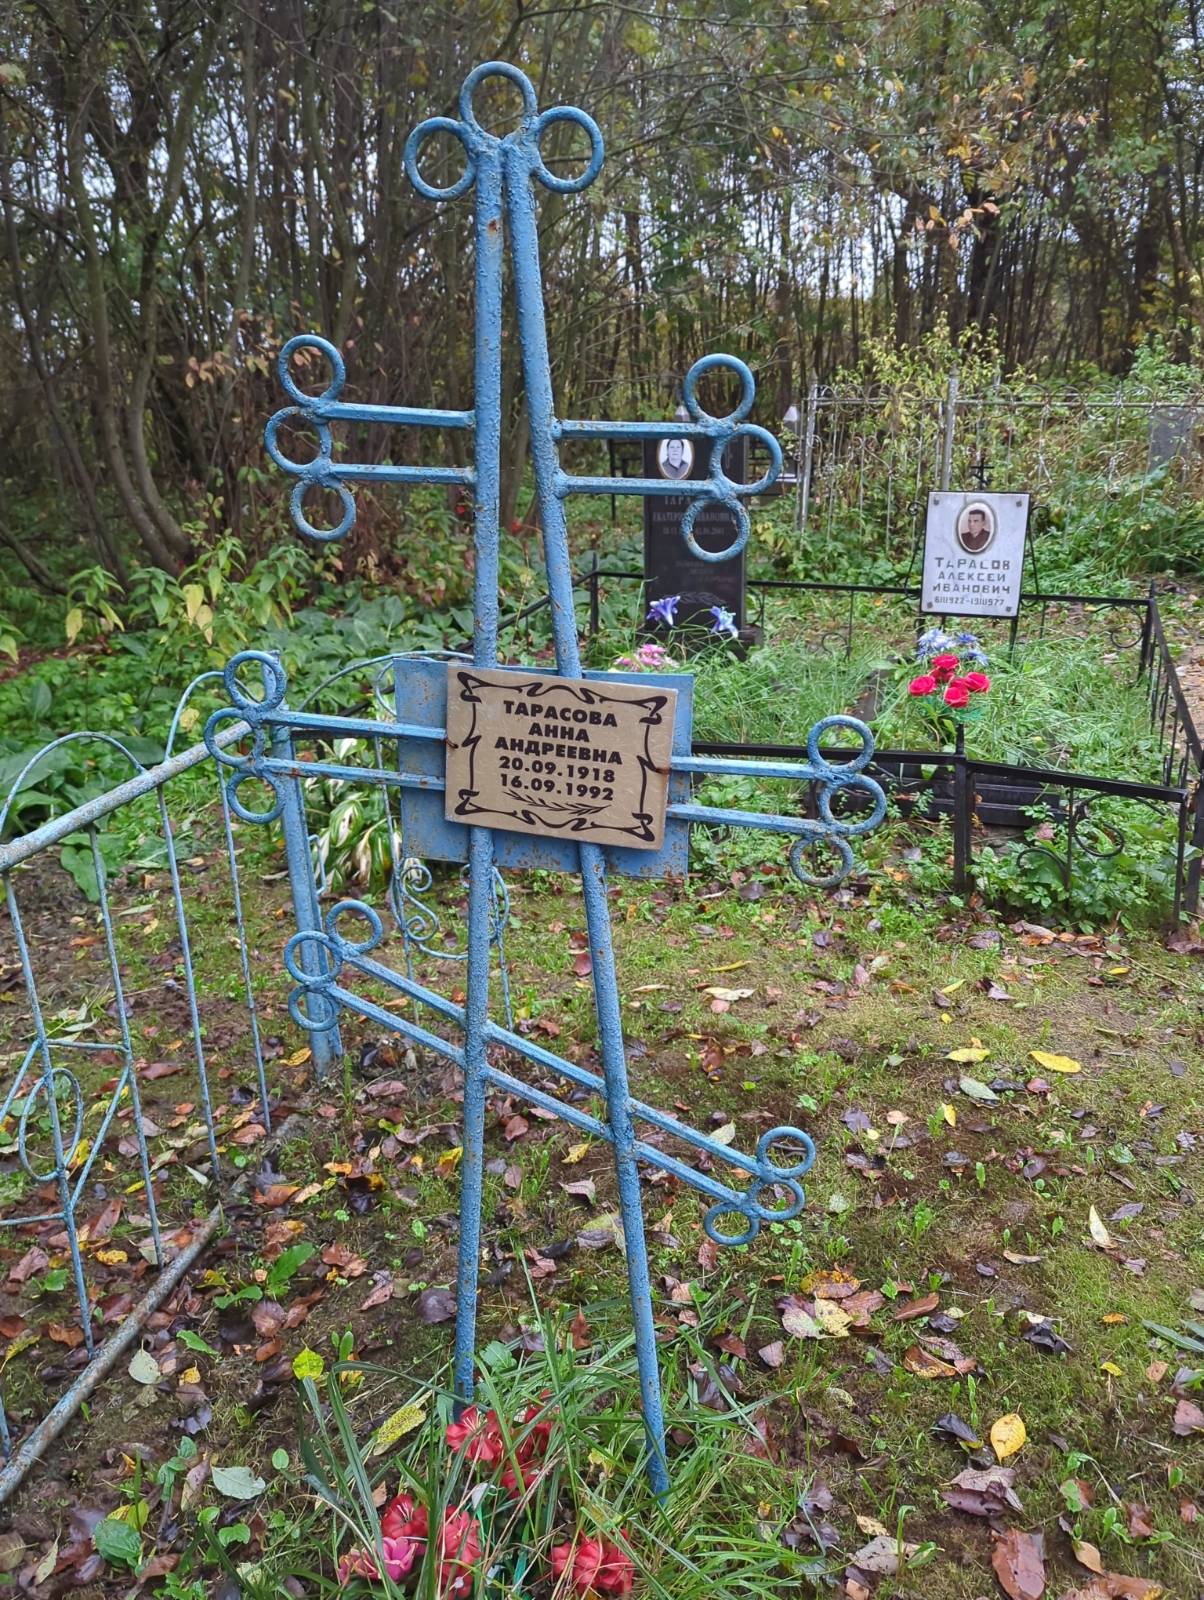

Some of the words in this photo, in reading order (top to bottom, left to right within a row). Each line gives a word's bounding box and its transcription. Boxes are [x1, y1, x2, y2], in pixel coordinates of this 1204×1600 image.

[935, 557, 1010, 570] ТАРАСОВ
[933, 583, 1010, 594] ИВАНОВИЧ
[503, 700, 618, 727] ТАРАСОВА
[529, 722, 590, 743] АННА
[495, 737, 623, 765] АНДРЕЕВНА
[499, 756, 615, 783] 20.09.1918
[500, 773, 614, 801] 16.09.1992
